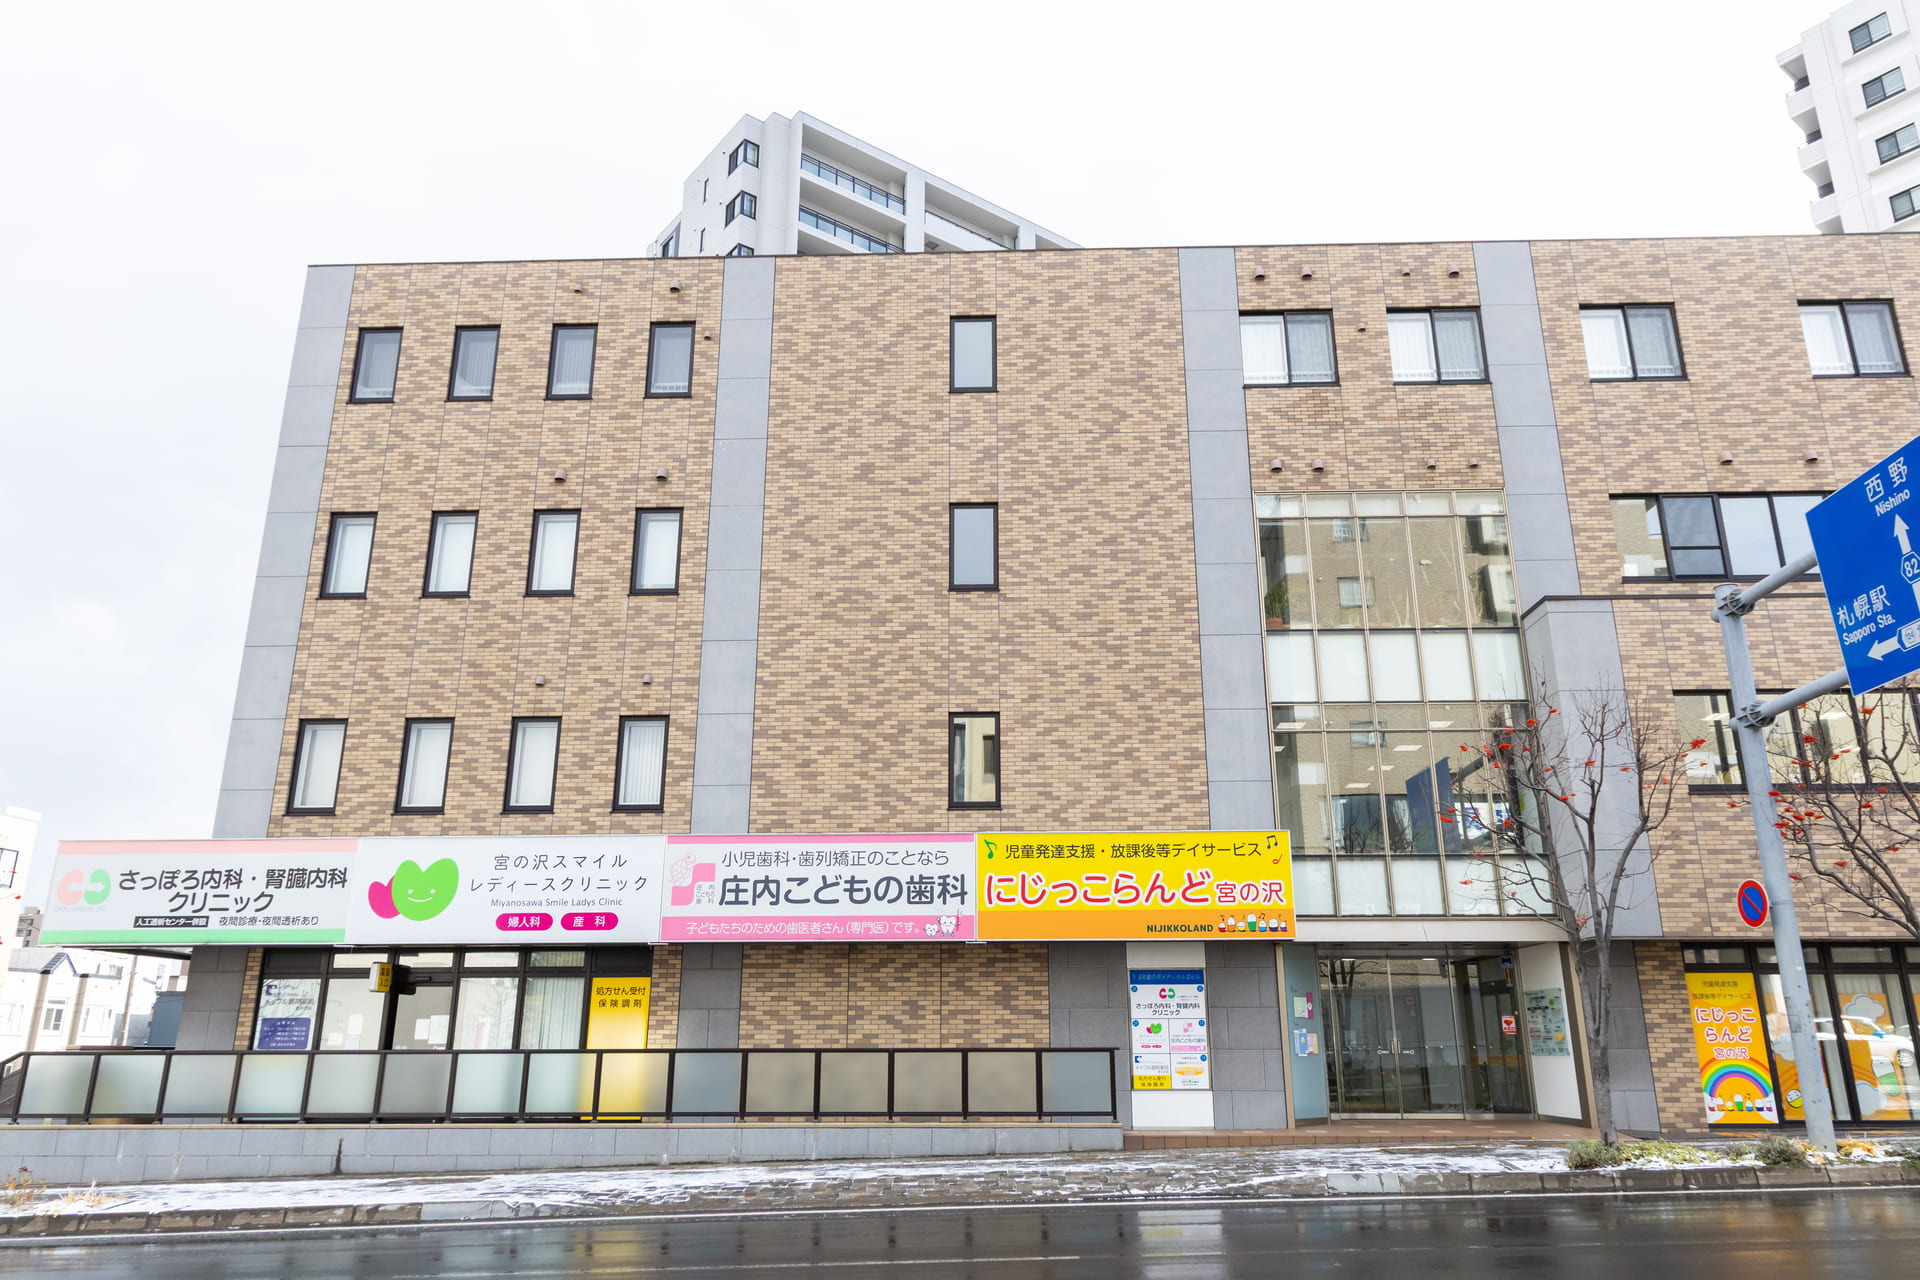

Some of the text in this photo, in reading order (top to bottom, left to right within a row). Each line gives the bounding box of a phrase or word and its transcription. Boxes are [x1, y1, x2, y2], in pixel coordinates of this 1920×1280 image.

[1864, 457, 1908, 503] 西野
[1875, 489, 1910, 517] Nishino
[1904, 559, 1919, 578] 82
[1837, 585, 1891, 629] 札幌駅
[1843, 612, 1896, 646] Sapporo Sta.
[722, 850, 949, 867] 小児歯科・歯列矯正のことなら
[1005, 842, 1262, 859] 児童発達支援・放課後等デイサービス
[494, 853, 628, 871] 宮の沢スマイル
[118, 868, 348, 890] さっぽろ内科・腎臓内科
[470, 876, 648, 893] レディースクリニック
[985, 869, 1284, 906] にじっこらんど 宮の沢
[719, 874, 968, 906] 庄内こどもの歯科
[168, 892, 274, 914] クリニック
[490, 897, 623, 908] Miyanosawa Smile Ladys Clinic
[507, 916, 541, 928] 婦人科
[1146, 923, 1214, 933] NIJIKKOLAND
[1695, 1007, 1756, 1023] にじっこ
[1705, 1027, 1752, 1043] らんど
